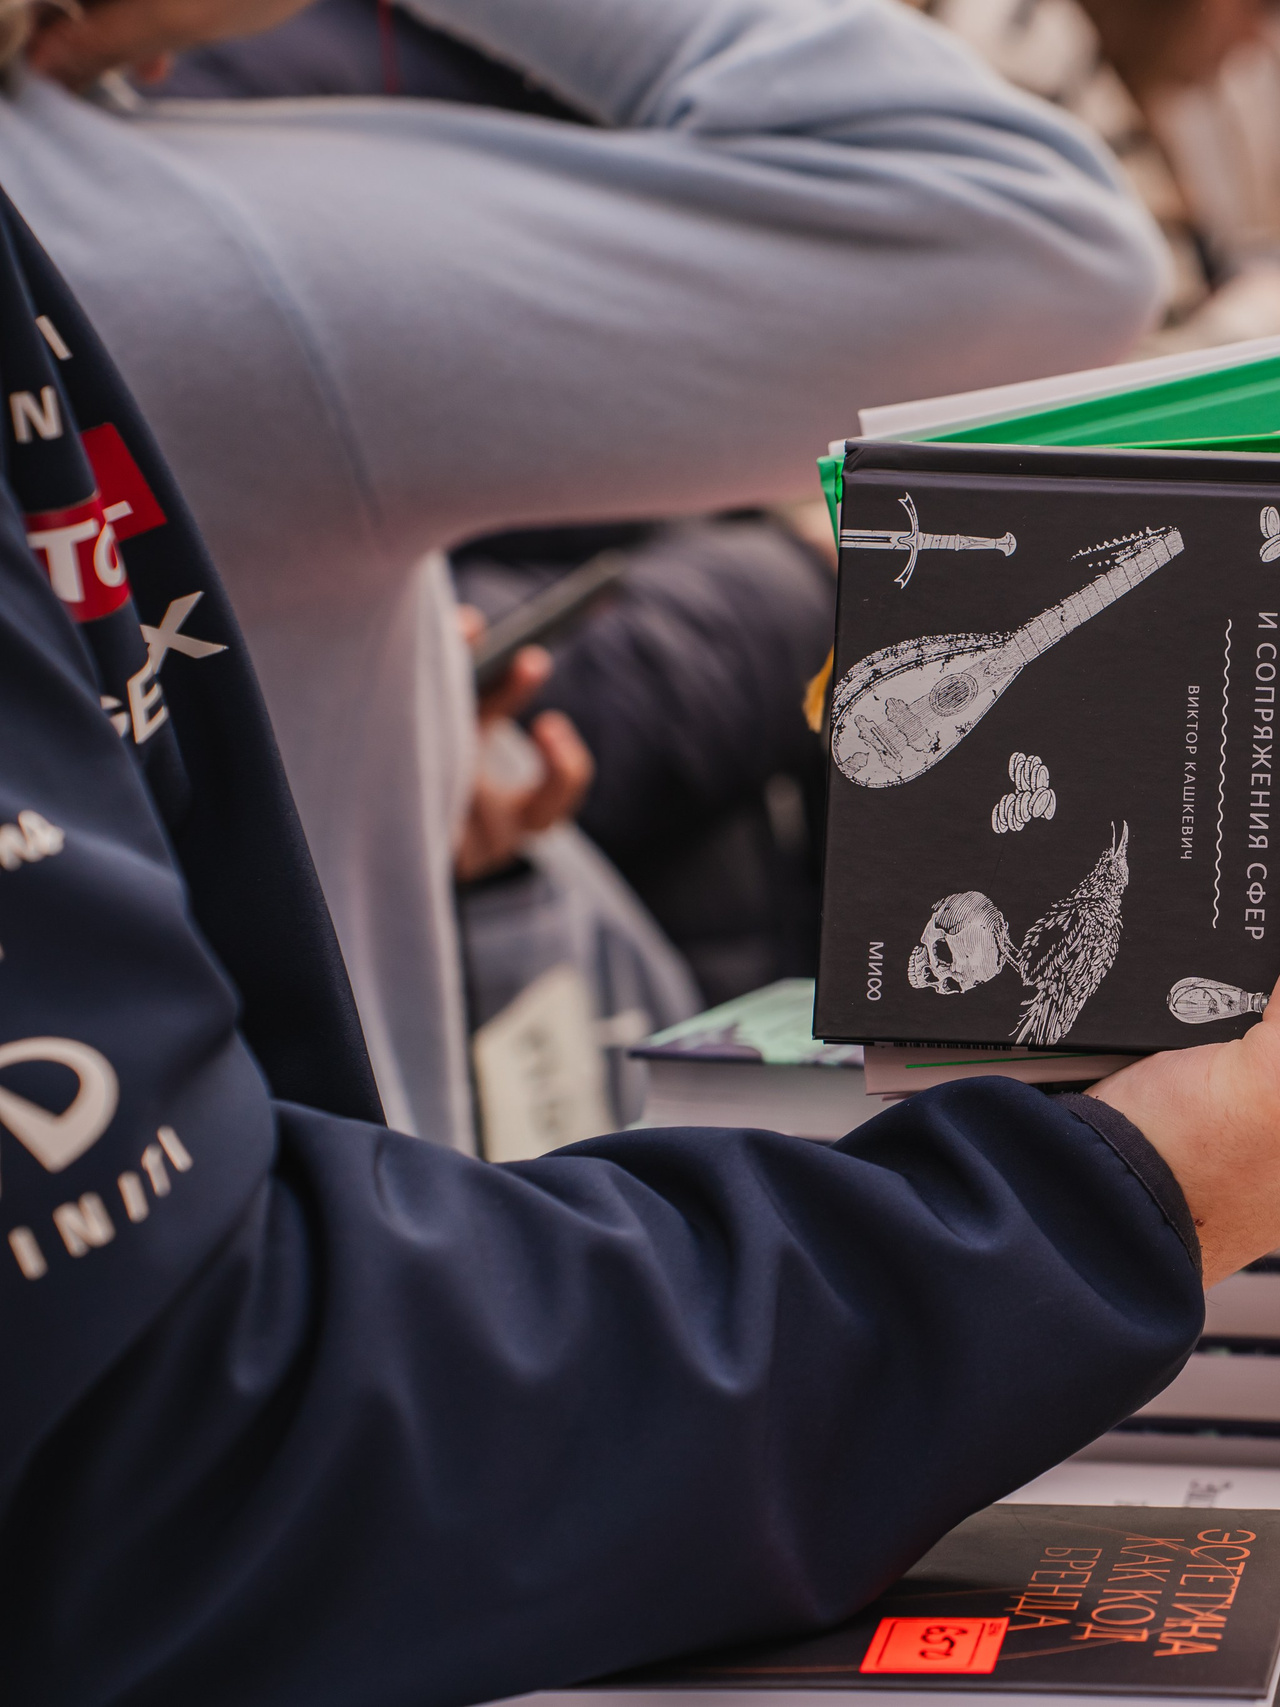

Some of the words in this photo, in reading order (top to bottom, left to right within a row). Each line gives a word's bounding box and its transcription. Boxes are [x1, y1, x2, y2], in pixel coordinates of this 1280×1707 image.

[1257, 611, 1278, 630] И
[1184, 684, 1200, 755] ВИКТОР
[1247, 641, 1278, 849] СОПРЯЖЕНИЯ
[1179, 761, 1197, 861] КАШКЕВИЧ
[1244, 862, 1268, 940] СФЕР
[1004, 1547, 1103, 1632] БРЕНДА
[1107, 1537, 1185, 1582] КАК
[1153, 1528, 1257, 1657] ЭСТЕТИКА
[1071, 1588, 1163, 1643] КОД
